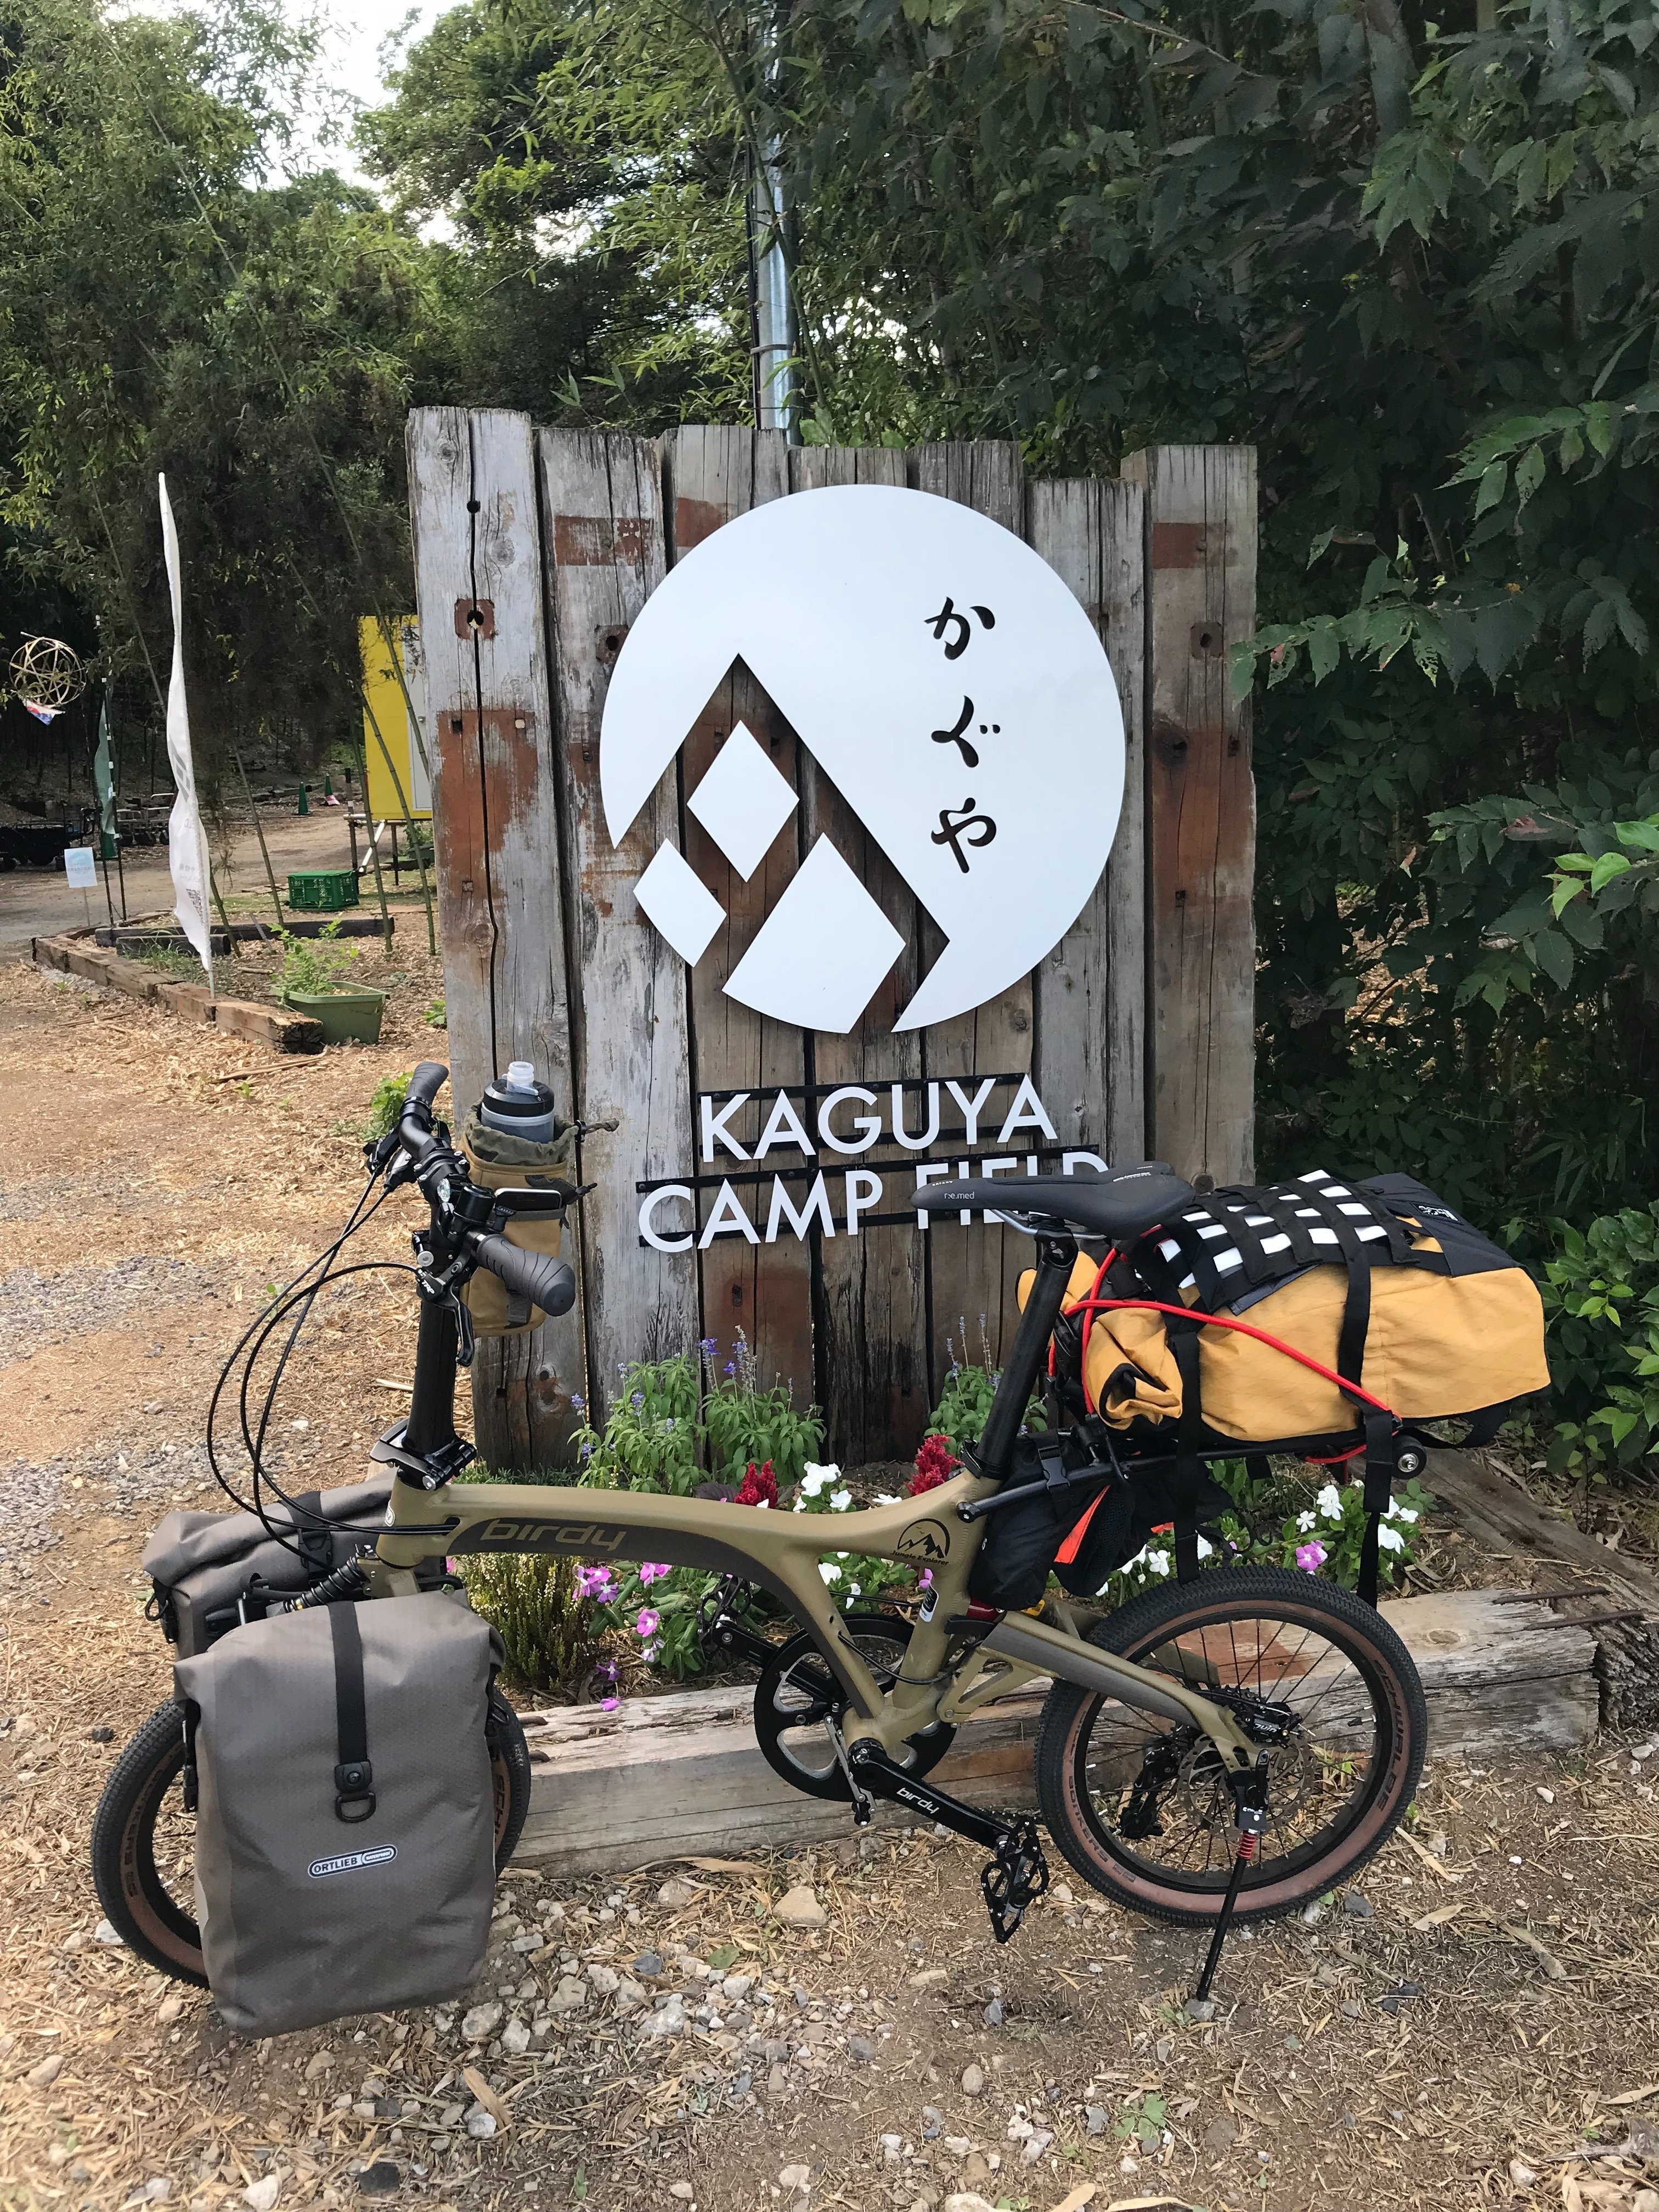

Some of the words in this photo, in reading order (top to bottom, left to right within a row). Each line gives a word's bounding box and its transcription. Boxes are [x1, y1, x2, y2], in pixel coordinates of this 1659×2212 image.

[924, 596, 1000, 873] かぐや
[700, 1074, 1058, 1163] KAGUYA
[638, 1170, 883, 1253] CAMP
[481, 1519, 627, 1551] birdy
[890, 1550, 916, 1559] Jungle
[917, 1555, 949, 1565] Explorer
[896, 1787, 940, 1814] birdy
[313, 1857, 357, 1874] ORTLIEB
